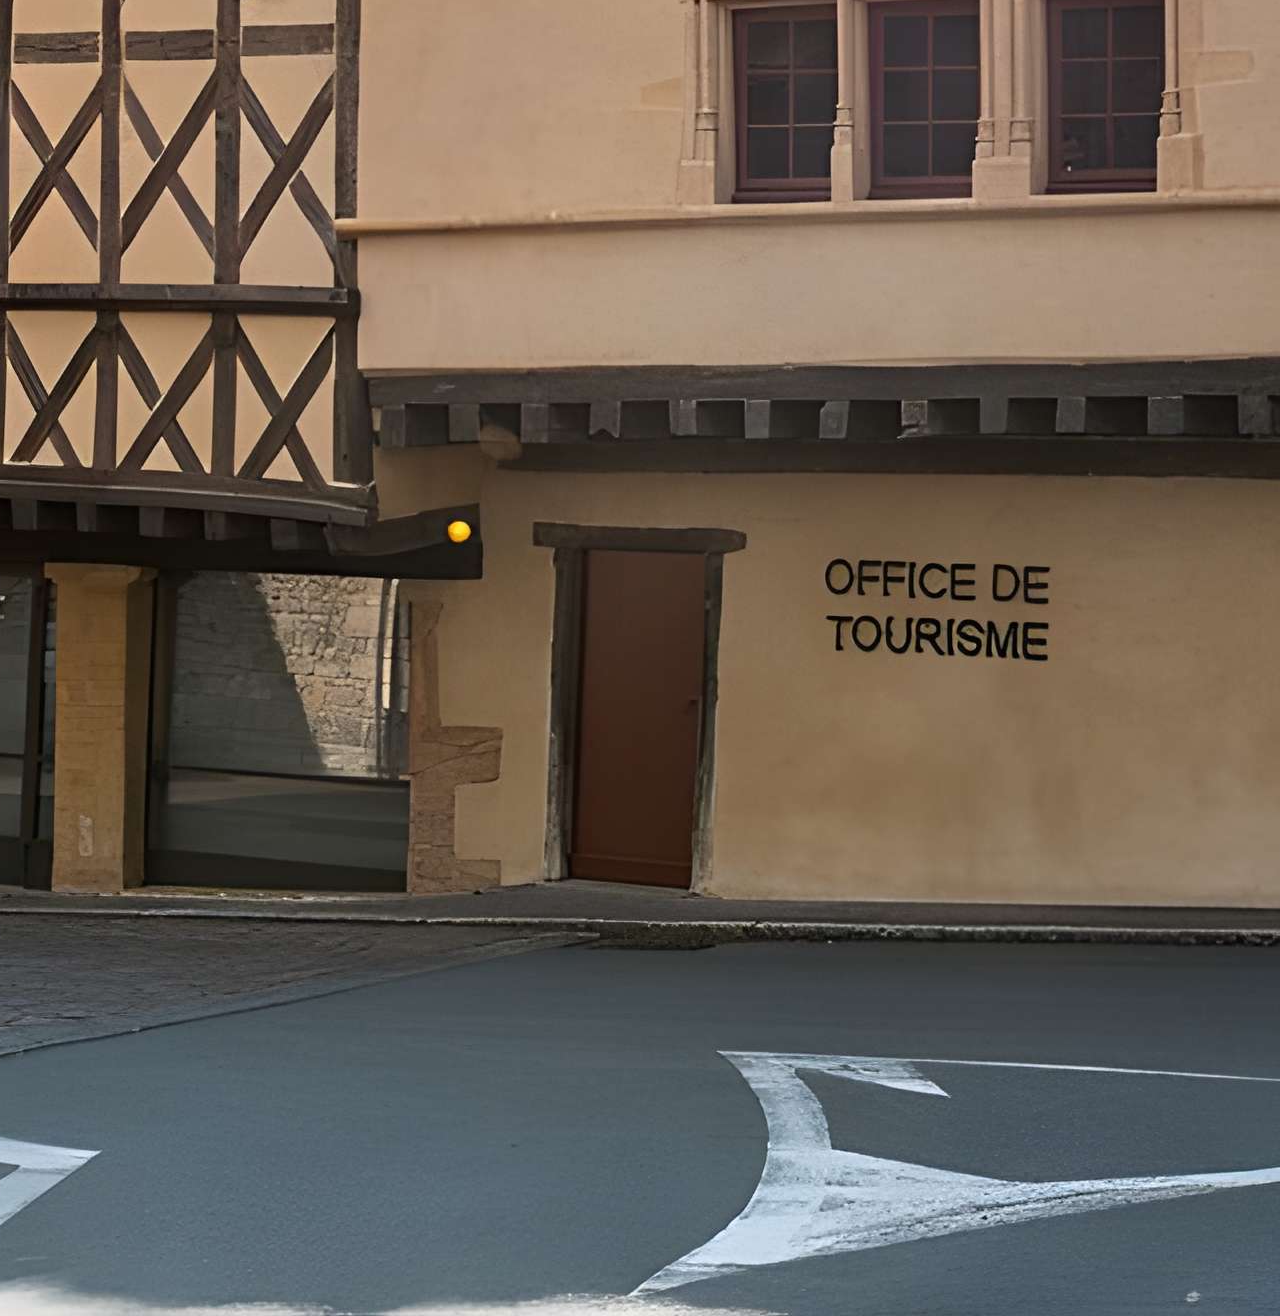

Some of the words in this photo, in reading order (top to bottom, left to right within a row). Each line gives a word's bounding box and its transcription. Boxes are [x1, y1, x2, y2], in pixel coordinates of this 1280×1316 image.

[825, 558, 976, 601] OFFICE
[992, 564, 1050, 604] DE
[826, 615, 1049, 661] TOURISME
